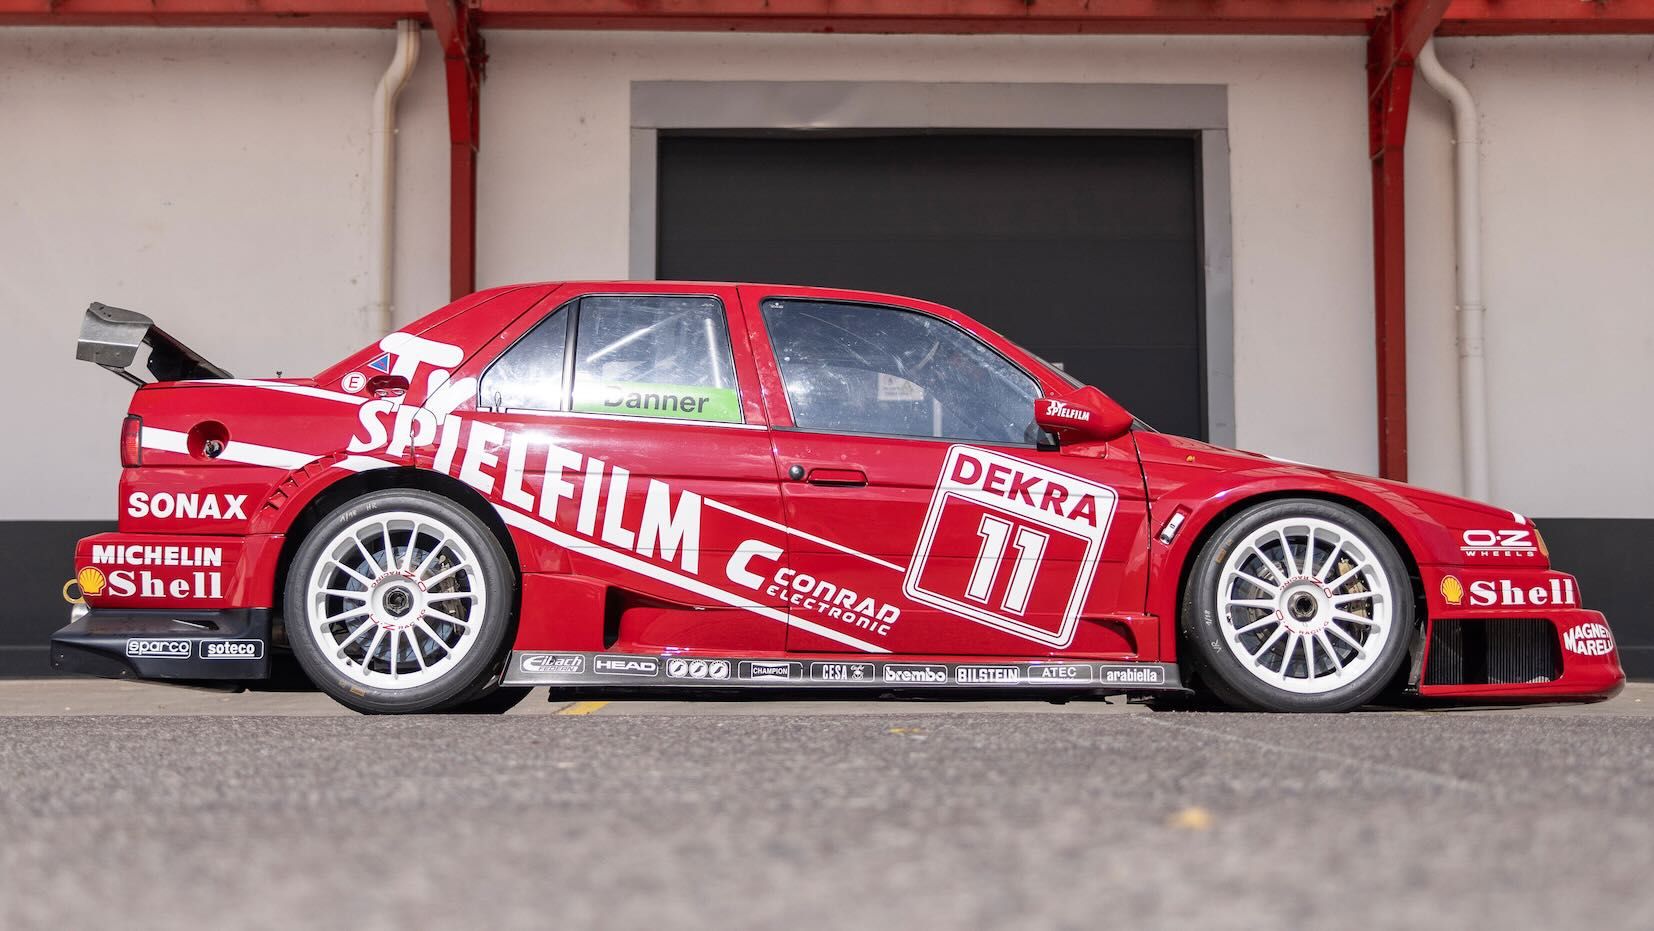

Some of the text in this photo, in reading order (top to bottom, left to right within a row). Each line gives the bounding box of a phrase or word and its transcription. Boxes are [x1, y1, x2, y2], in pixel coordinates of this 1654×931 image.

[348, 376, 360, 389] E
[604, 385, 710, 414] Danner
[1046, 406, 1090, 421] SPIELFILM
[345, 399, 702, 575] SPIELFILM
[951, 453, 1097, 528] DEKRA
[128, 492, 248, 520] SONAX
[92, 544, 222, 567] MICHELIN
[964, 513, 1050, 616] 11
[108, 570, 223, 599] Shell
[1279, 575, 1309, 591] RACING
[773, 567, 901, 624] CONRAD
[1470, 579, 1576, 606] Shell
[766, 584, 891, 636] ELECTRONIC
[398, 608, 426, 630] RACNG
[128, 641, 190, 655] sparco
[208, 641, 256, 654] soteco
[523, 655, 582, 671] Eibach
[596, 660, 657, 671] HEAD
[753, 667, 788, 676] CHAMPION
[822, 664, 848, 680] CESA
[885, 667, 946, 682] brembo
[958, 668, 1018, 682] BILSTEIN
[1041, 667, 1077, 677] ATEC
